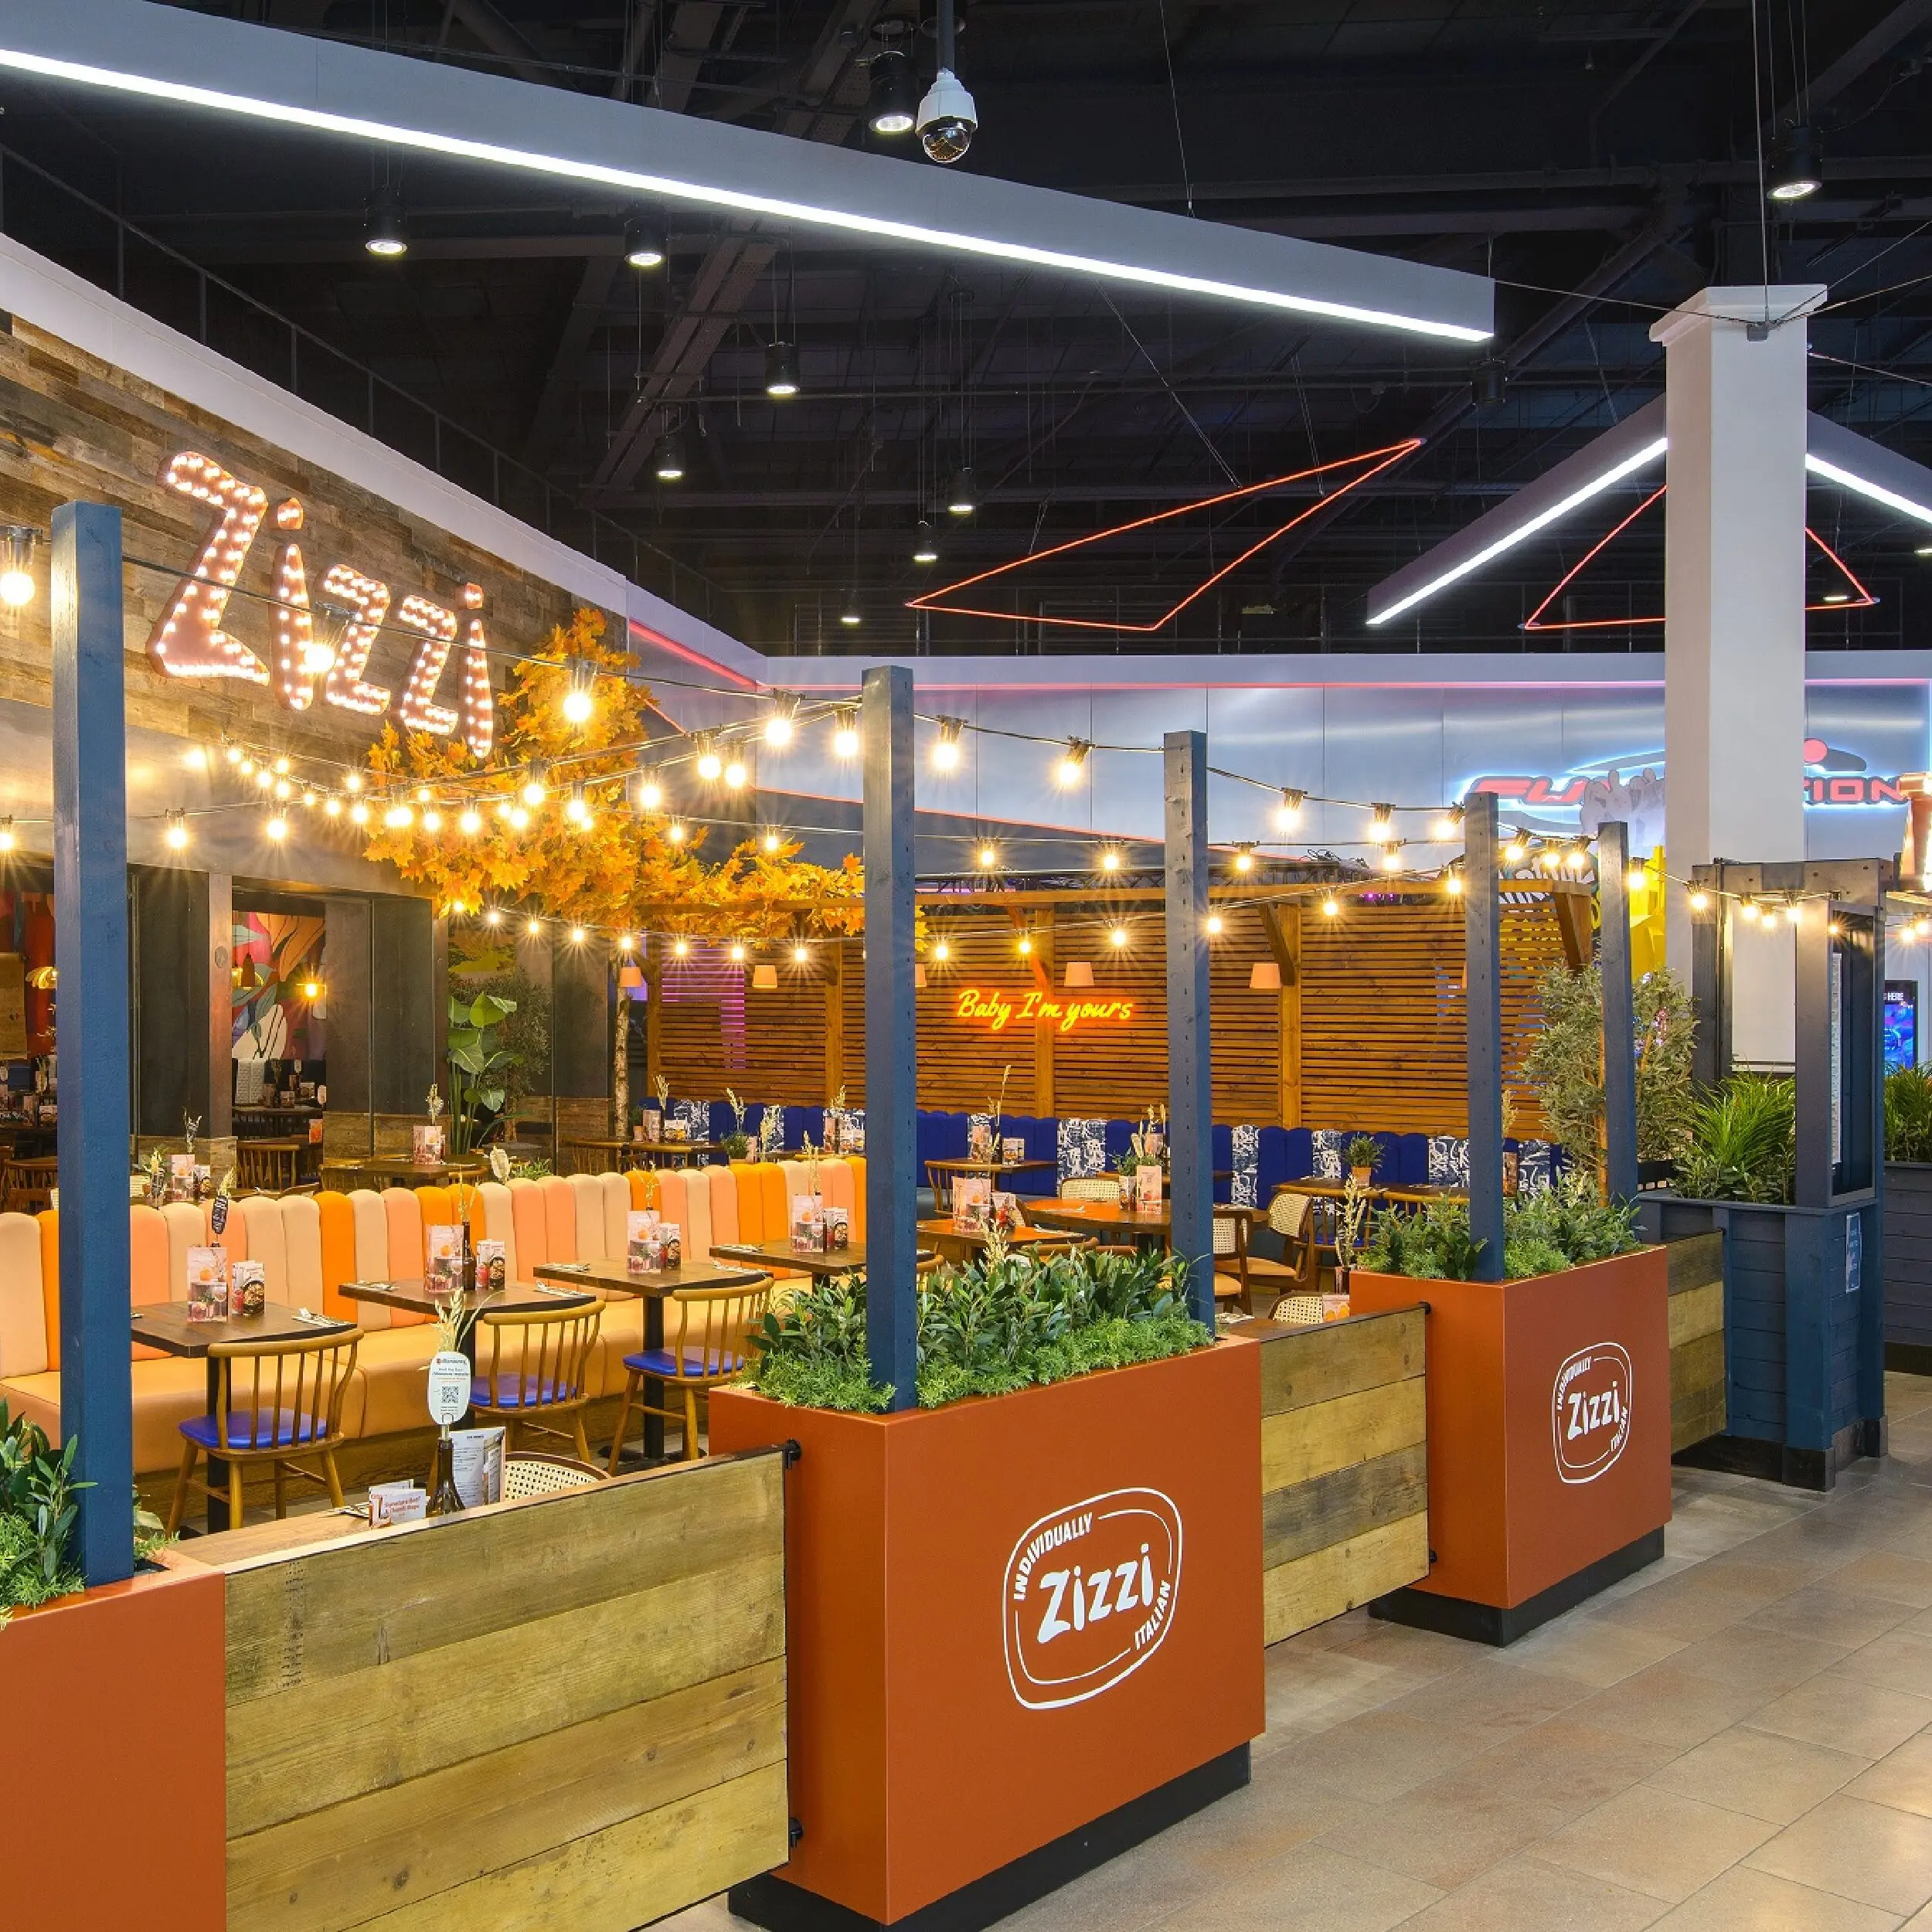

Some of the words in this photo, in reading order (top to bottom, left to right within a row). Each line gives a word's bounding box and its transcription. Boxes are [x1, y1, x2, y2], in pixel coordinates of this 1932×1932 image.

[147, 451, 493, 758] Zizzi
[957, 989, 1011, 1031] Baby
[1015, 992, 1063, 1019] I'm
[1060, 1002, 1134, 1032] yours
[1567, 1380, 1620, 1440] Zizzi
[1013, 1512, 1093, 1601] INDIVIDUALLY
[1037, 1543, 1154, 1645] Zizzi
[1134, 1580, 1171, 1650] ITALIAN
